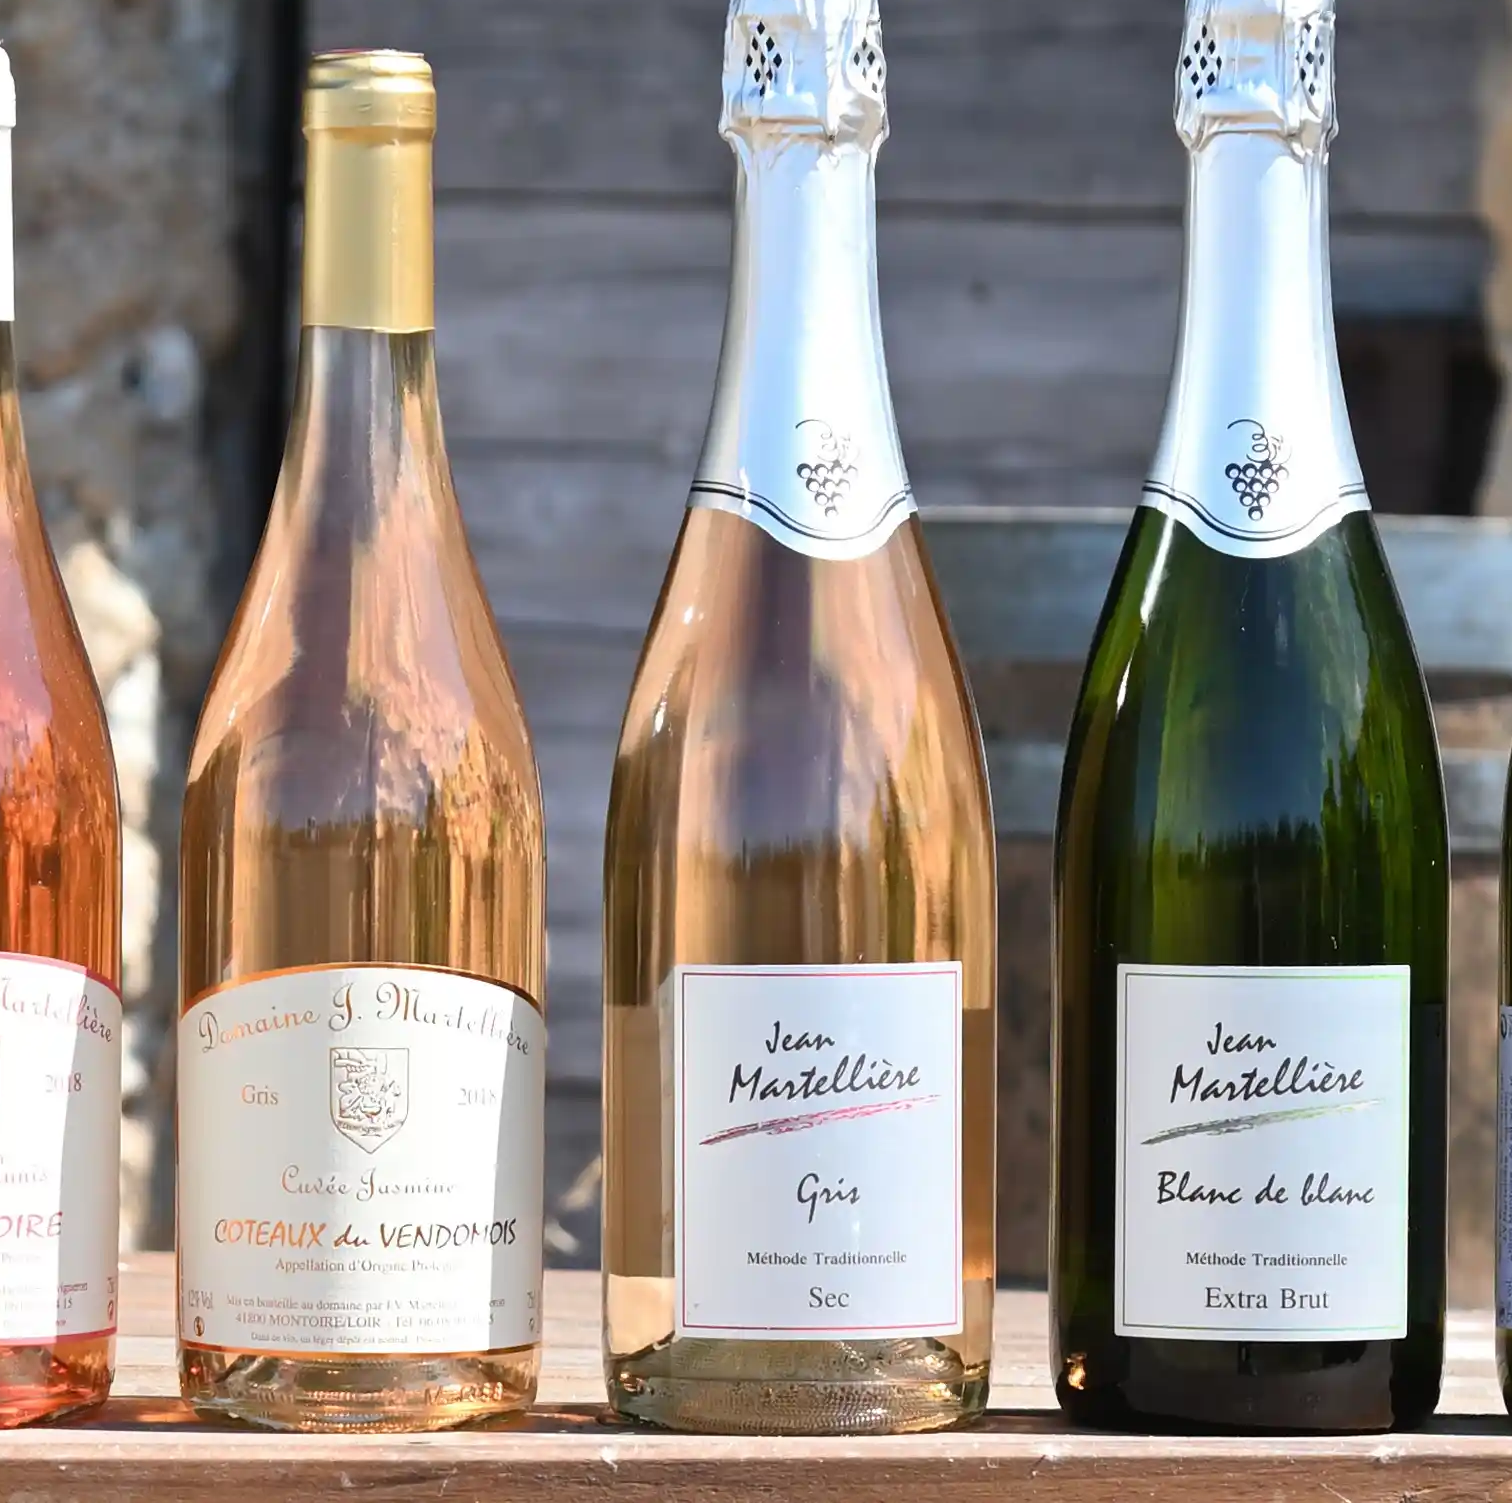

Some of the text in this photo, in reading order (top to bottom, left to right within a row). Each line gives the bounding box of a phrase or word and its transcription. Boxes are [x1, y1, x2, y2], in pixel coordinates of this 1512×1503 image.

[199, 1007, 320, 1053] Domaine
[329, 983, 363, 1032] J.
[766, 1021, 835, 1054] Jean
[1207, 1022, 1276, 1055] Jean
[45, 1073, 82, 1094] 2018
[241, 1083, 279, 1105] Gris
[729, 1055, 920, 1103] Martellière
[1170, 1056, 1364, 1103] Martellière
[281, 1164, 350, 1196] Cuvée
[1156, 1171, 1375, 1206] Blanc de blanc
[797, 1173, 860, 1223] Gris
[215, 1218, 517, 1250] COTEAUX du VENDOMOIS
[275, 1258, 345, 1273] Appellation
[747, 1251, 907, 1265] Méthode Traditionnelle
[1186, 1251, 1348, 1266] Méthode Traditionnelle
[809, 1287, 850, 1308] Sec
[1205, 1286, 1329, 1309] Extra Brut
